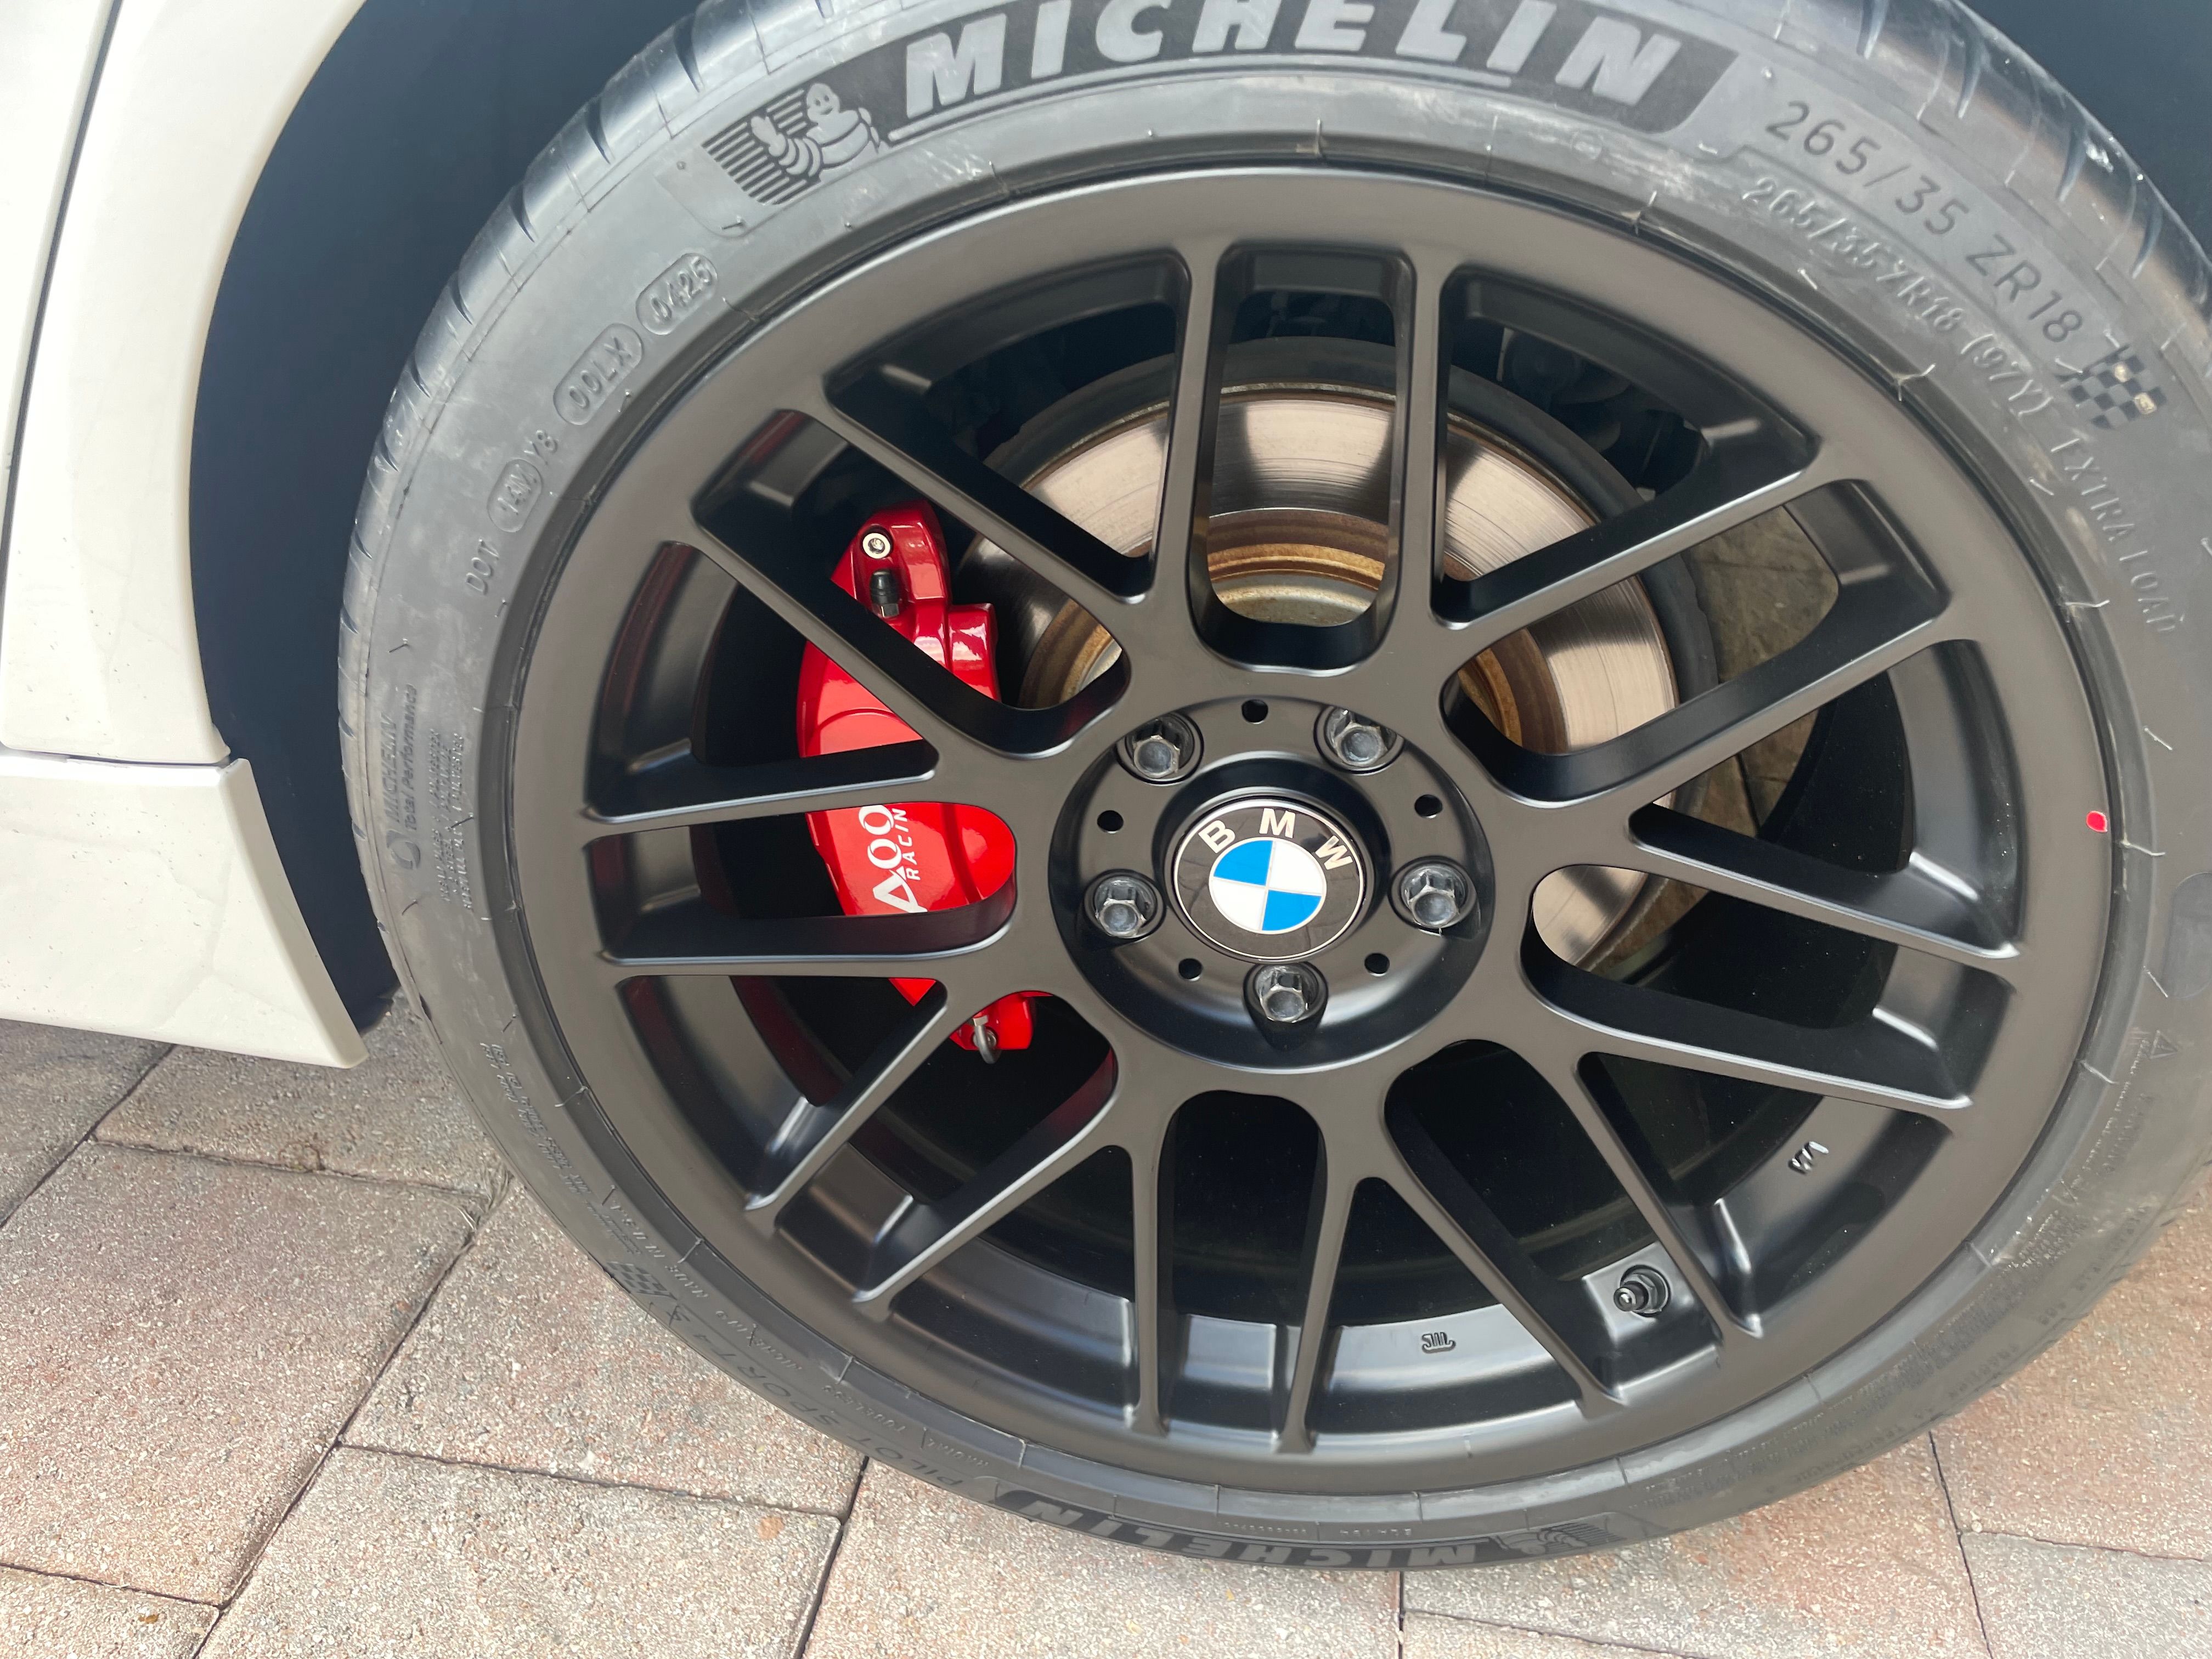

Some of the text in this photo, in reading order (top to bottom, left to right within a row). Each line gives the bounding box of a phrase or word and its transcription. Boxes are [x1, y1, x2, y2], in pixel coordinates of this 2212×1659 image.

[906, 0, 1682, 119] MICHELIN
[1765, 101, 2083, 343] 265/35 ZR18
[465, 539, 500, 595] DOT
[381, 712, 400, 823] MICHELIN
[891, 808, 921, 881] RACIN
[1199, 808, 1353, 870] BMW
[711, 1348, 840, 1425] SPORT
[847, 1435, 963, 1486] PILOT
[1019, 1500, 1476, 1566] MICHELIN
